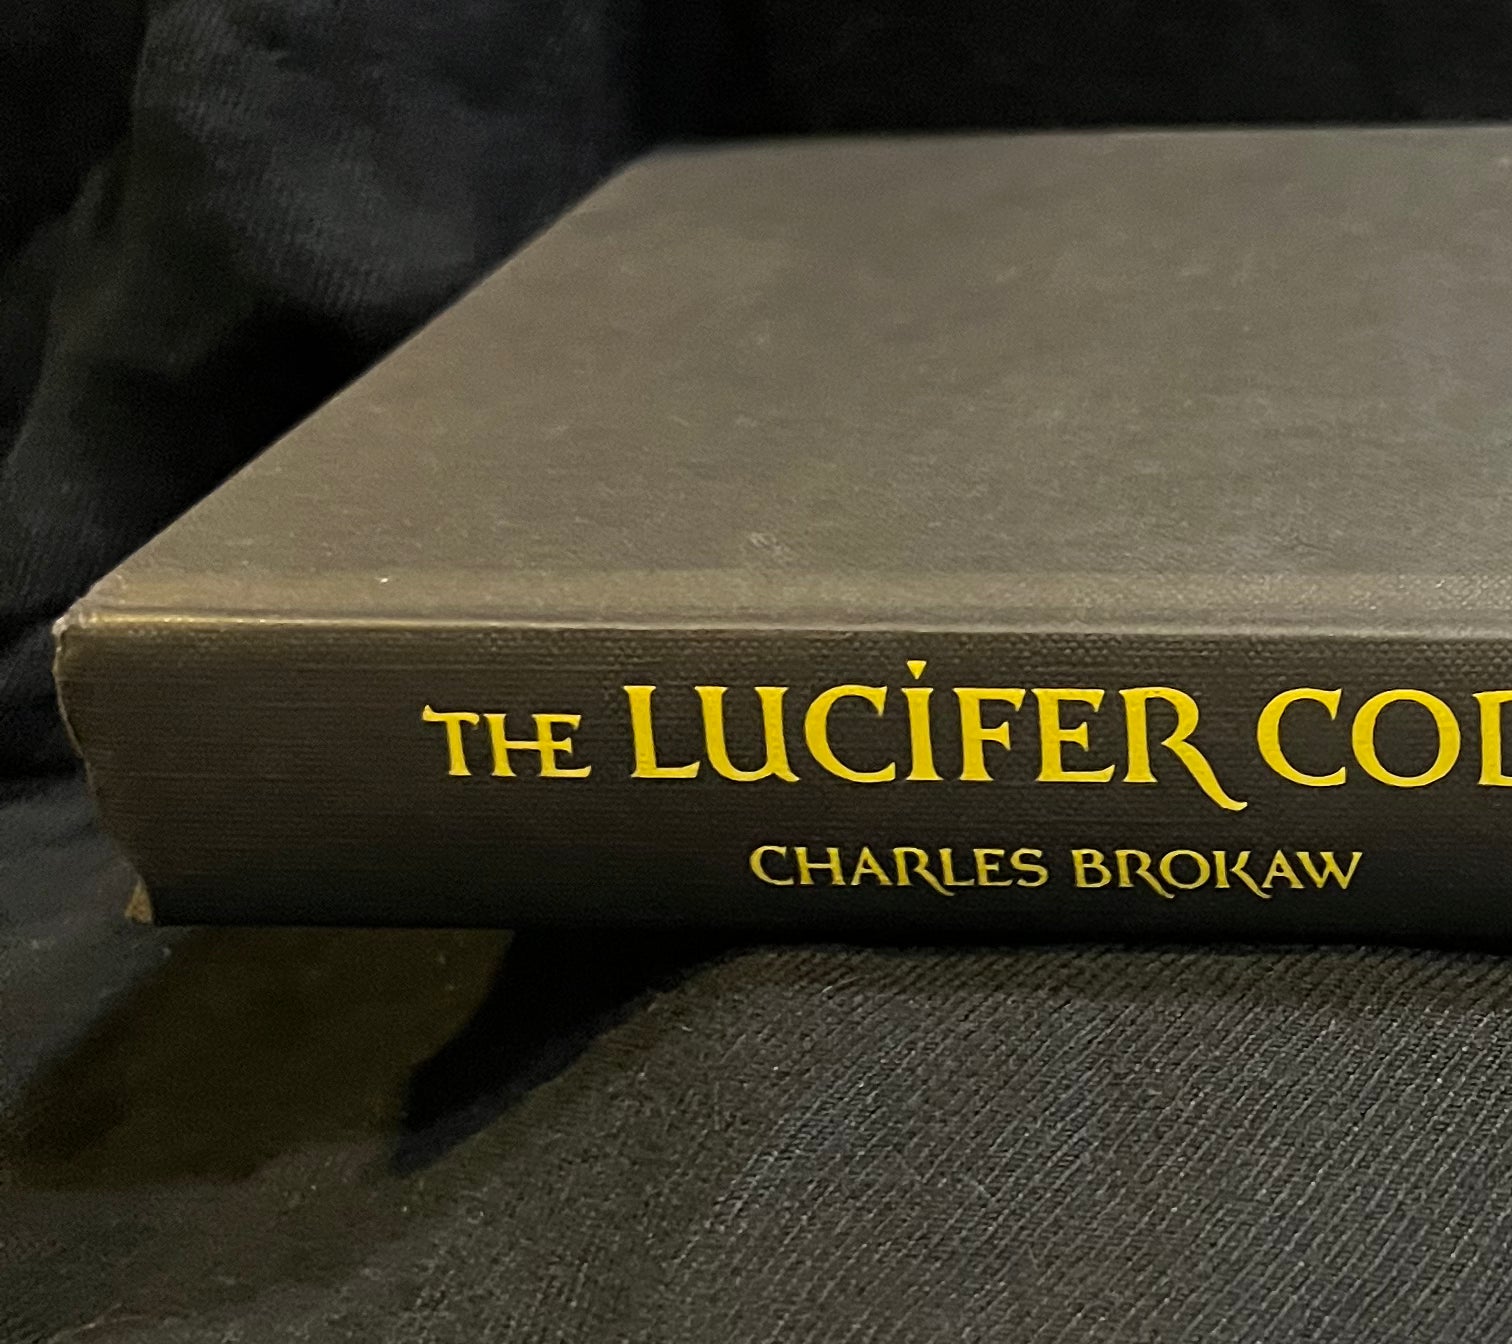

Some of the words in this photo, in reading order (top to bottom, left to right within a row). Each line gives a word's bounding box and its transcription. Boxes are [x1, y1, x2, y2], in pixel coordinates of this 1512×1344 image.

[421, 706, 592, 778] THE
[750, 847, 1048, 896] CHARLES
[1071, 849, 1362, 898] BROKAW
